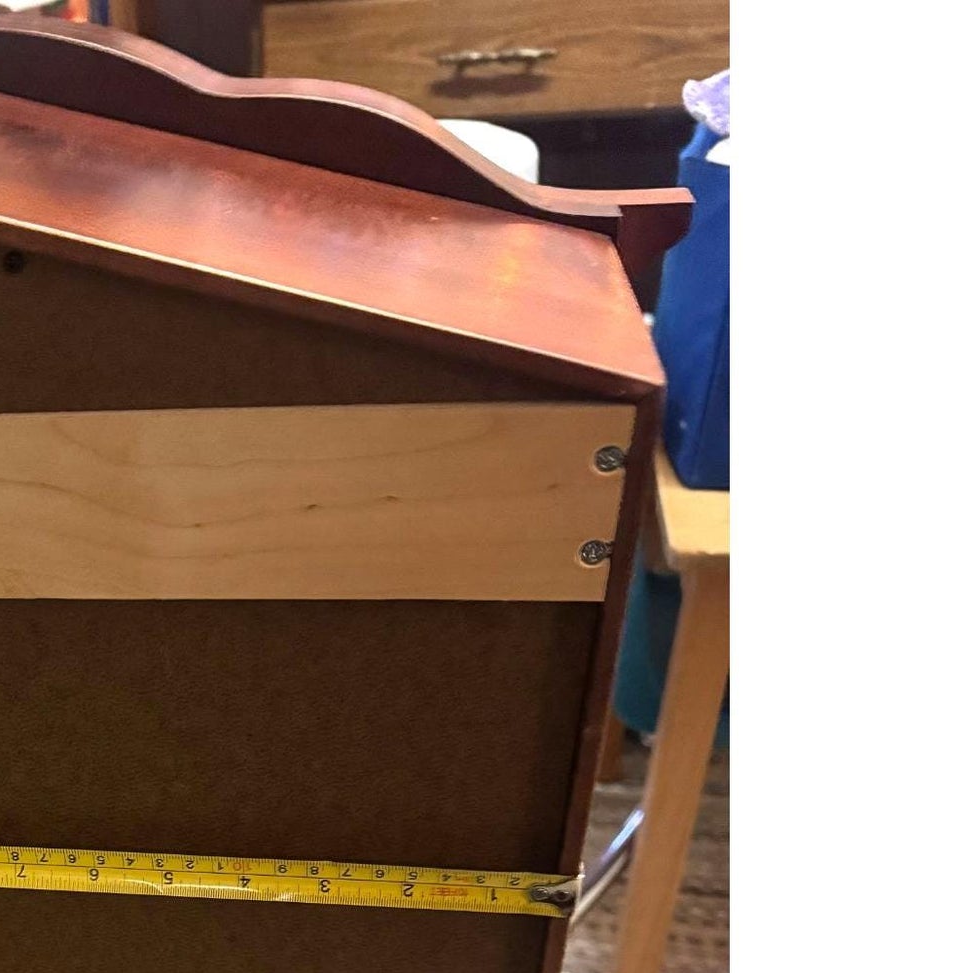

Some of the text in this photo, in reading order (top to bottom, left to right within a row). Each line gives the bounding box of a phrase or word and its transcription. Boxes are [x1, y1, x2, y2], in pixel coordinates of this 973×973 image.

[11, 851, 20, 861] 8
[39, 853, 49, 862] 7
[68, 854, 77, 864] 6
[96, 855, 106, 865] 5
[125, 858, 135, 866] 4
[155, 858, 164, 868] 3
[186, 860, 195, 869] 2
[217, 862, 224, 871] 1
[17, 865, 27, 878] 7
[277, 864, 288, 873] 9
[310, 866, 319, 875] 8
[341, 868, 352, 877] 7
[89, 868, 99, 881] 6
[163, 871, 174, 885] 5
[375, 869, 385, 879] 6
[409, 871, 418, 880] 5
[239, 875, 251, 888] 4
[476, 875, 485, 884] 3
[320, 879, 331, 893] 3
[403, 883, 414, 898] 2
[490, 888, 498, 902] 1
